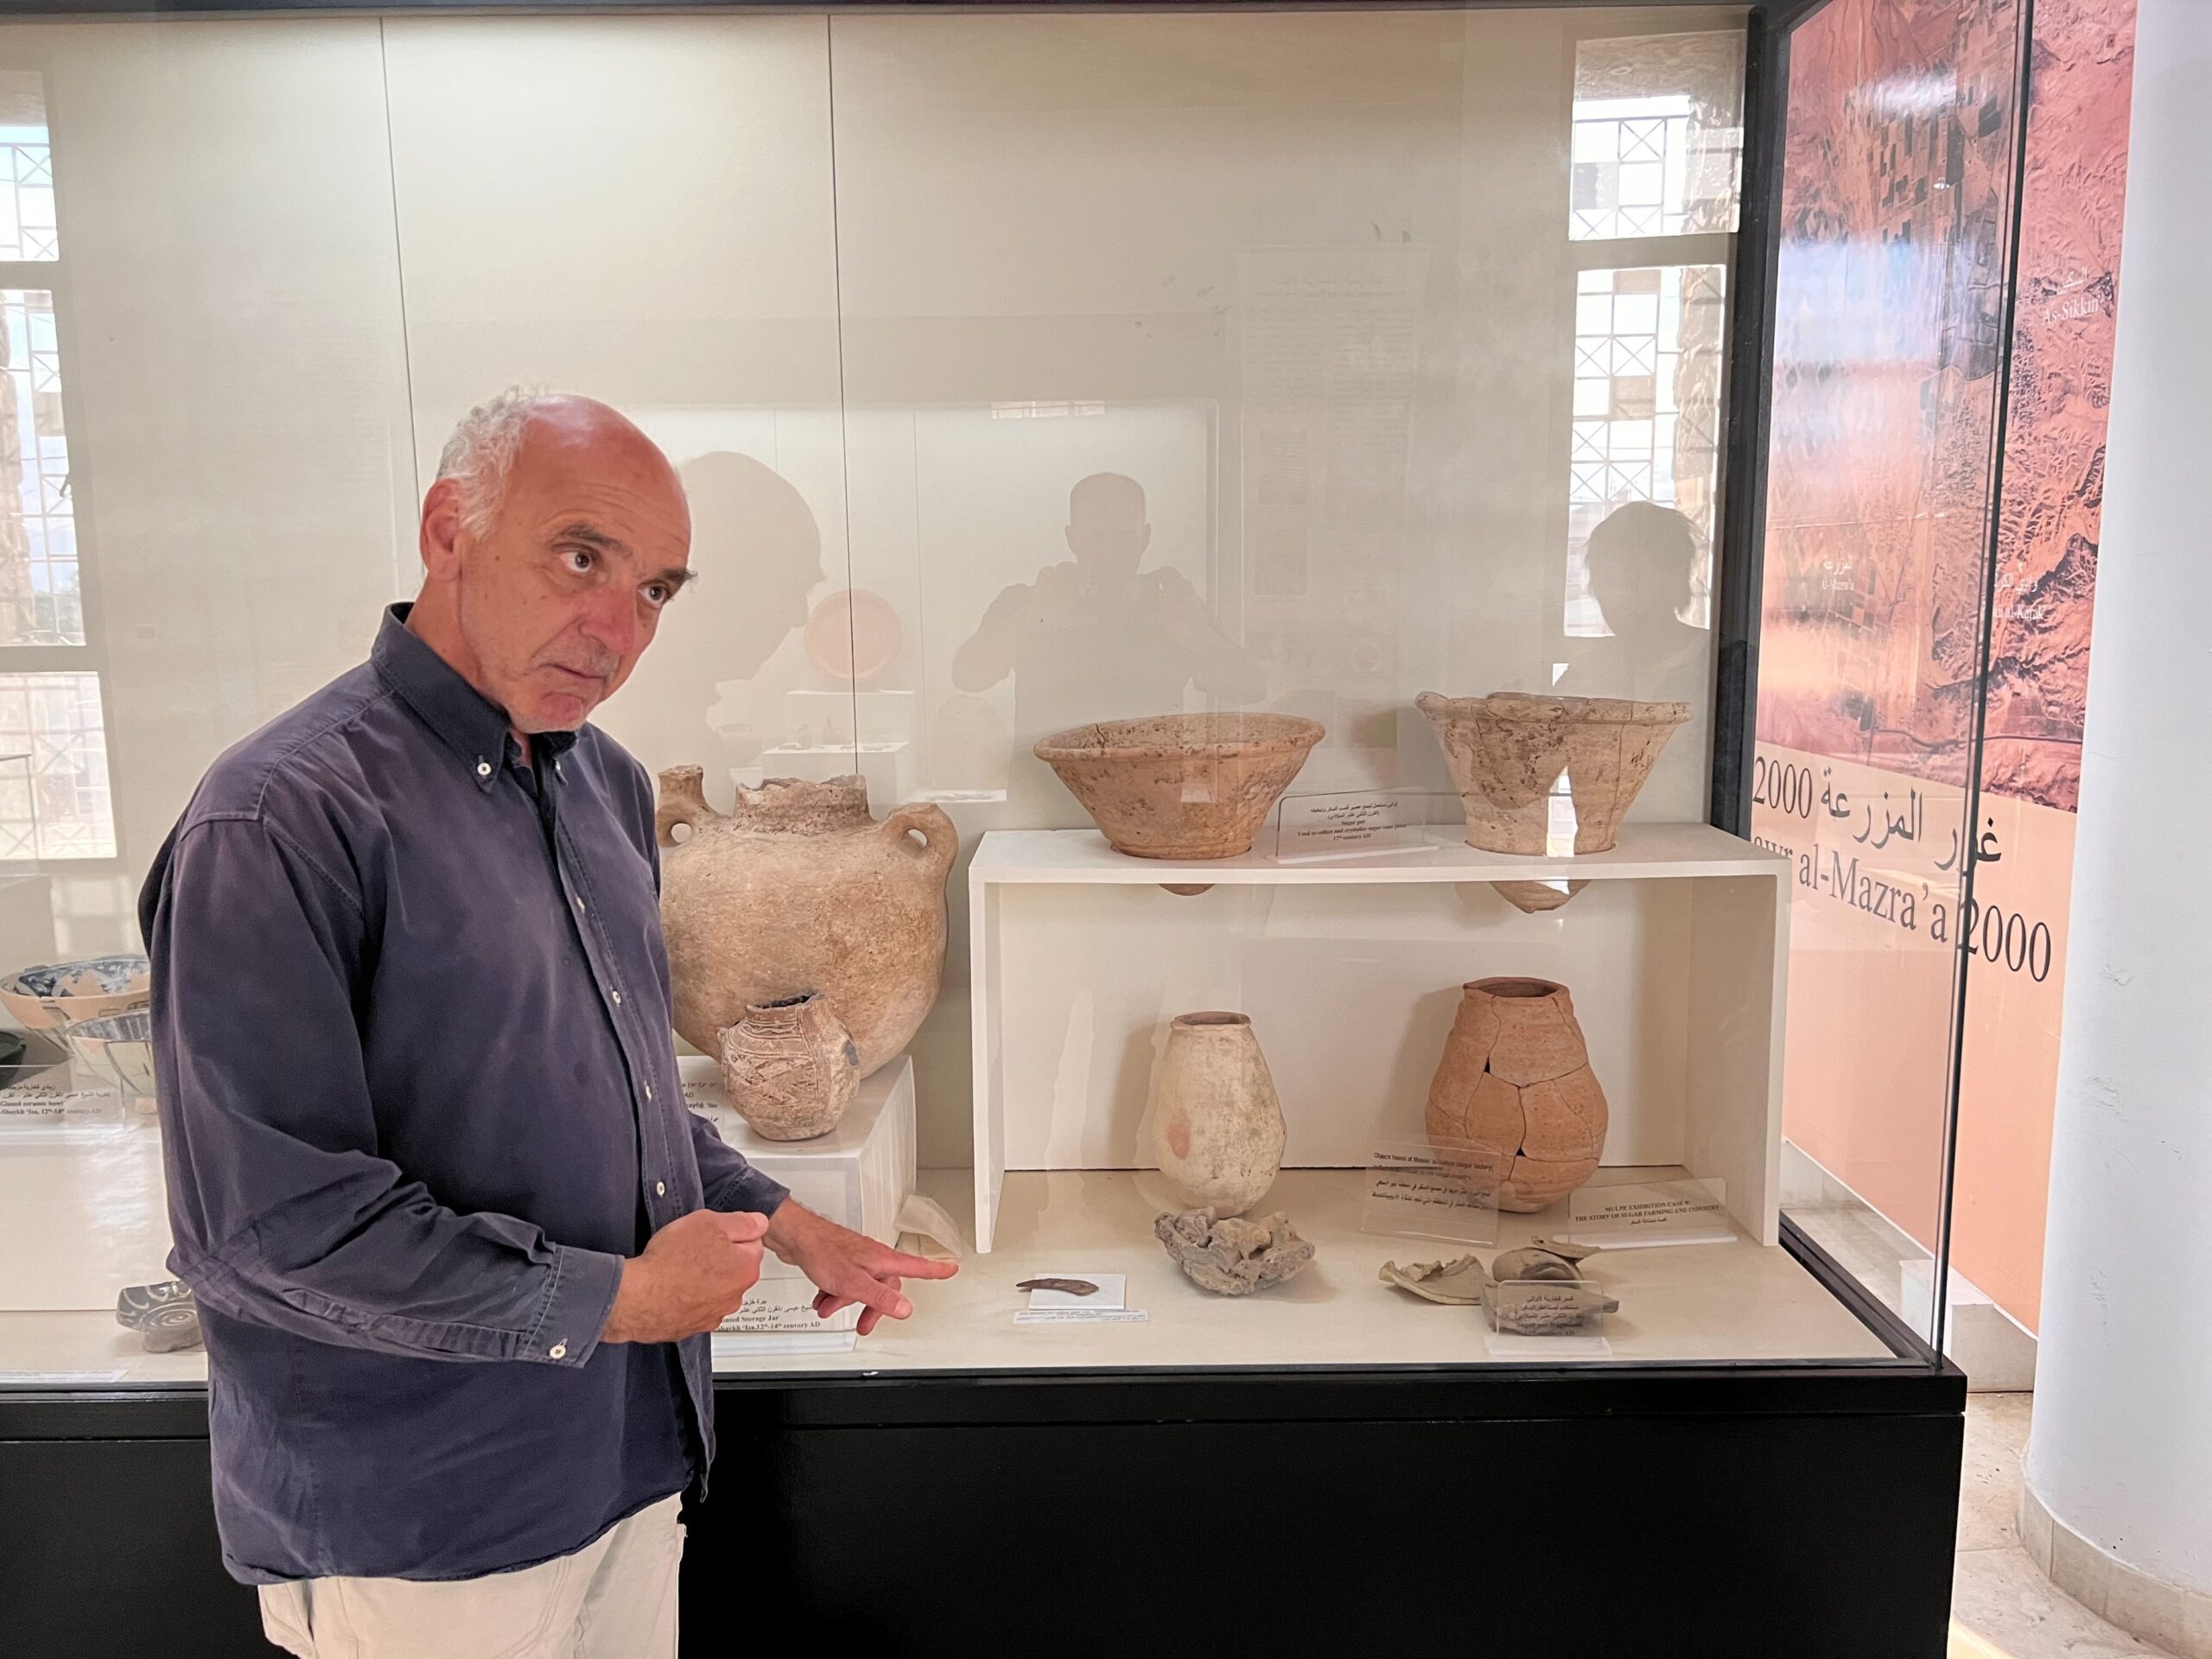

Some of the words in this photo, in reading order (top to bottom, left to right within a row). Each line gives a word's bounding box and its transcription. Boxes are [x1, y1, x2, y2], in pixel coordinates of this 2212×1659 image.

[1752, 755, 1813, 819] 2000
[1820, 766, 1923, 849] المزرعة
[1956, 896, 2052, 983] 2000
[1588, 1212, 1610, 1221] STORY
[1621, 1210, 1643, 1218] SUGAR
[1688, 1204, 1719, 1212] INDUSTRY
[1628, 1201, 1667, 1211] EXHIBITION
